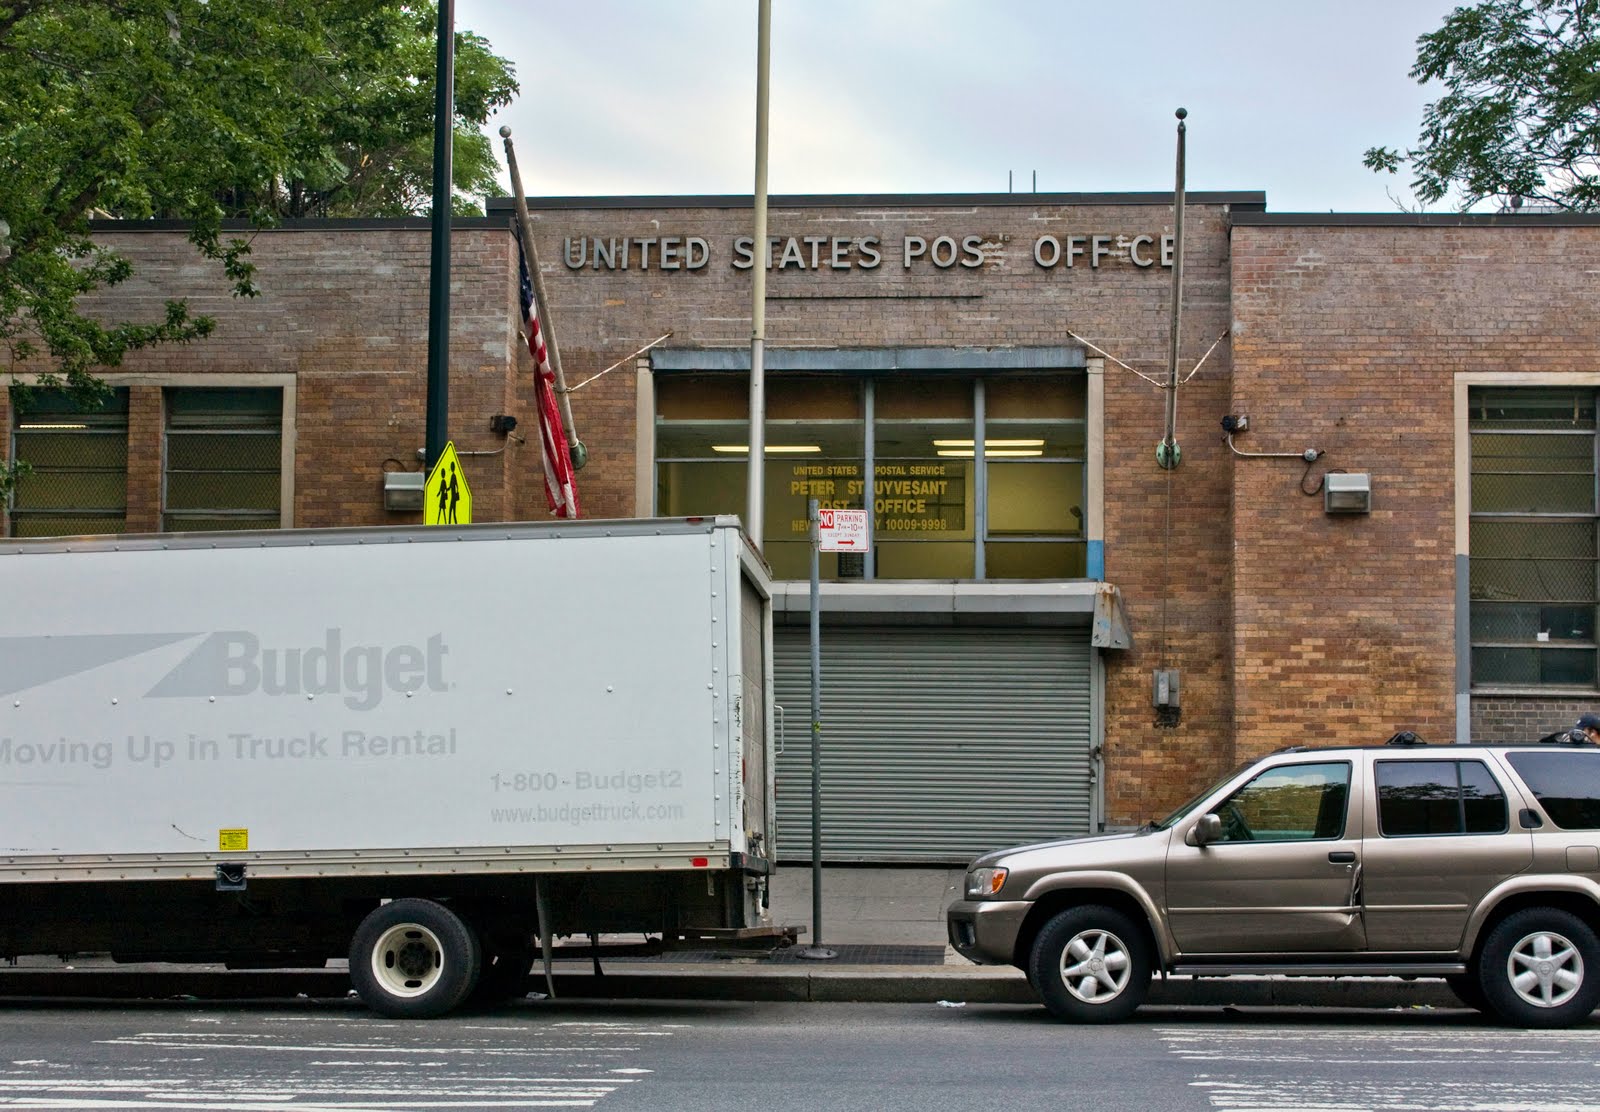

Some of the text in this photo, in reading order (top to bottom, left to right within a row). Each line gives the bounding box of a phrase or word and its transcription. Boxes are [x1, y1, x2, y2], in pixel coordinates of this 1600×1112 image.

[563, 236, 711, 269] UNITED
[731, 235, 882, 269] STATES
[793, 466, 945, 475] UNITED STATES POSTAL SERVICE
[791, 481, 835, 495] PETER
[875, 499, 926, 513] OFFICE
[820, 512, 863, 527] NO PARKING
[886, 519, 947, 530] 10009-9998
[212, 628, 449, 711] Budget
[127, 735, 175, 768] Up
[189, 734, 218, 761] in
[229, 732, 328, 759] Truck
[342, 728, 456, 757] Rental
